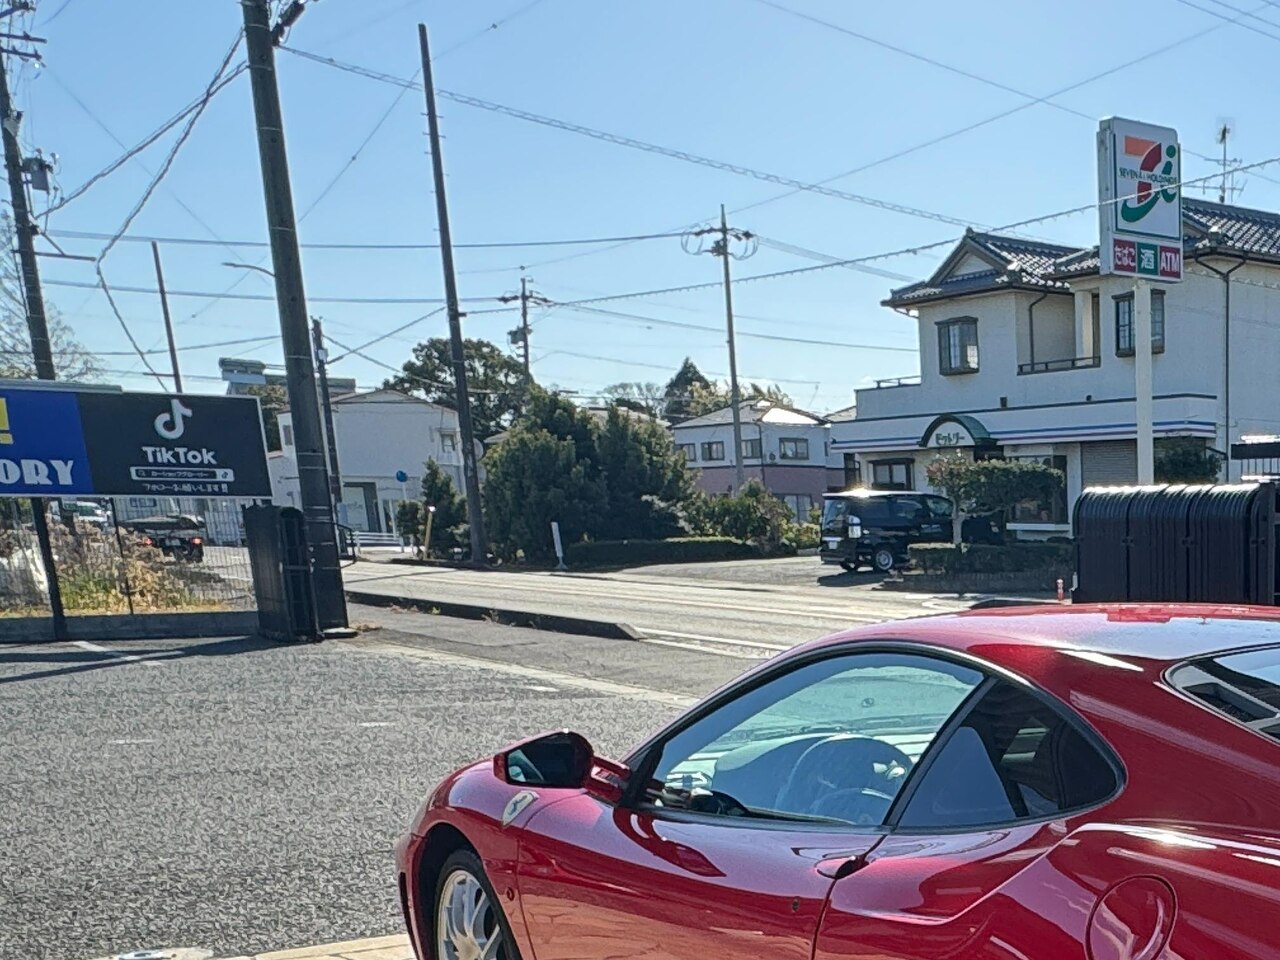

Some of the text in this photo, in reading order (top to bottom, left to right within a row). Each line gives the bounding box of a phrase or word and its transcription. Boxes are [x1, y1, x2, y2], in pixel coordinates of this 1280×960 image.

[1115, 246, 1136, 266] たばこ
[1140, 248, 1155, 269] 酒
[1160, 252, 1180, 272] ATM
[142, 446, 217, 464] TikTok
